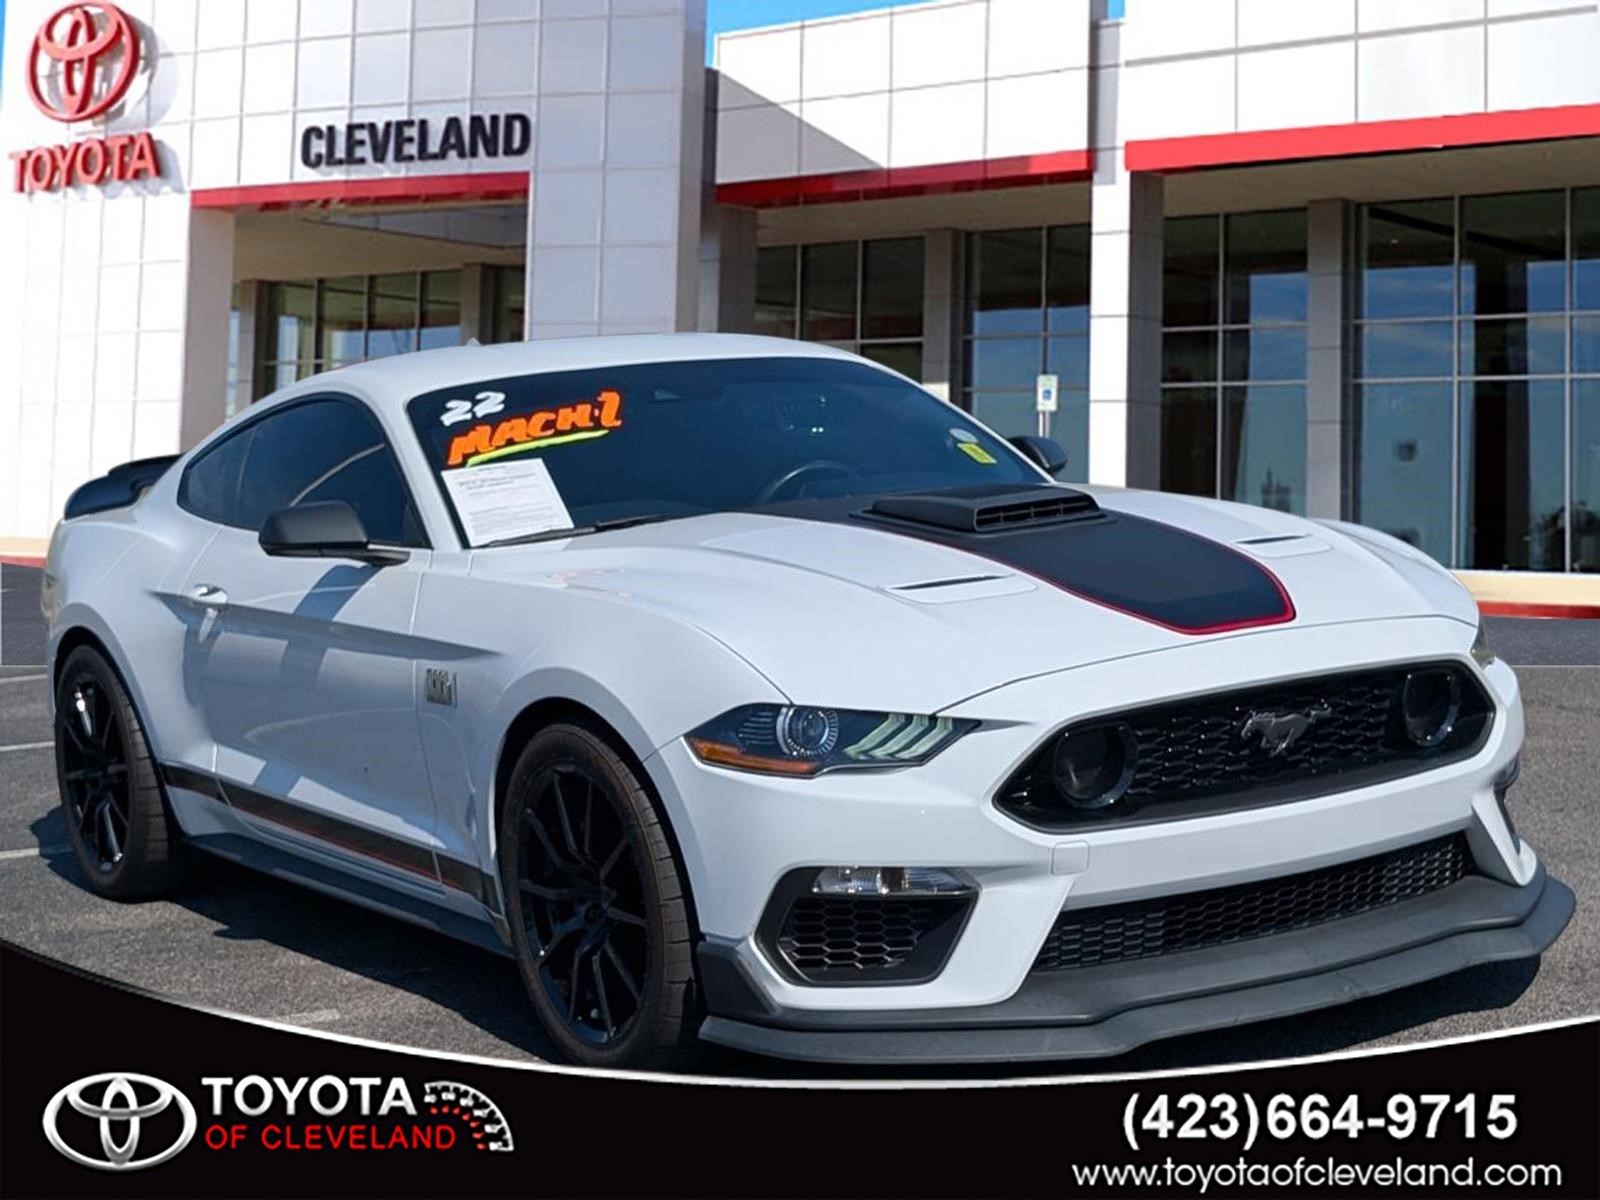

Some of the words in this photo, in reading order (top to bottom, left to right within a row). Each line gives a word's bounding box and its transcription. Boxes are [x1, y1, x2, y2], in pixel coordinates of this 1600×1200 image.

[9, 131, 160, 193] TOYOTA
[301, 113, 531, 168] CLEVELAND
[440, 391, 506, 426] 22
